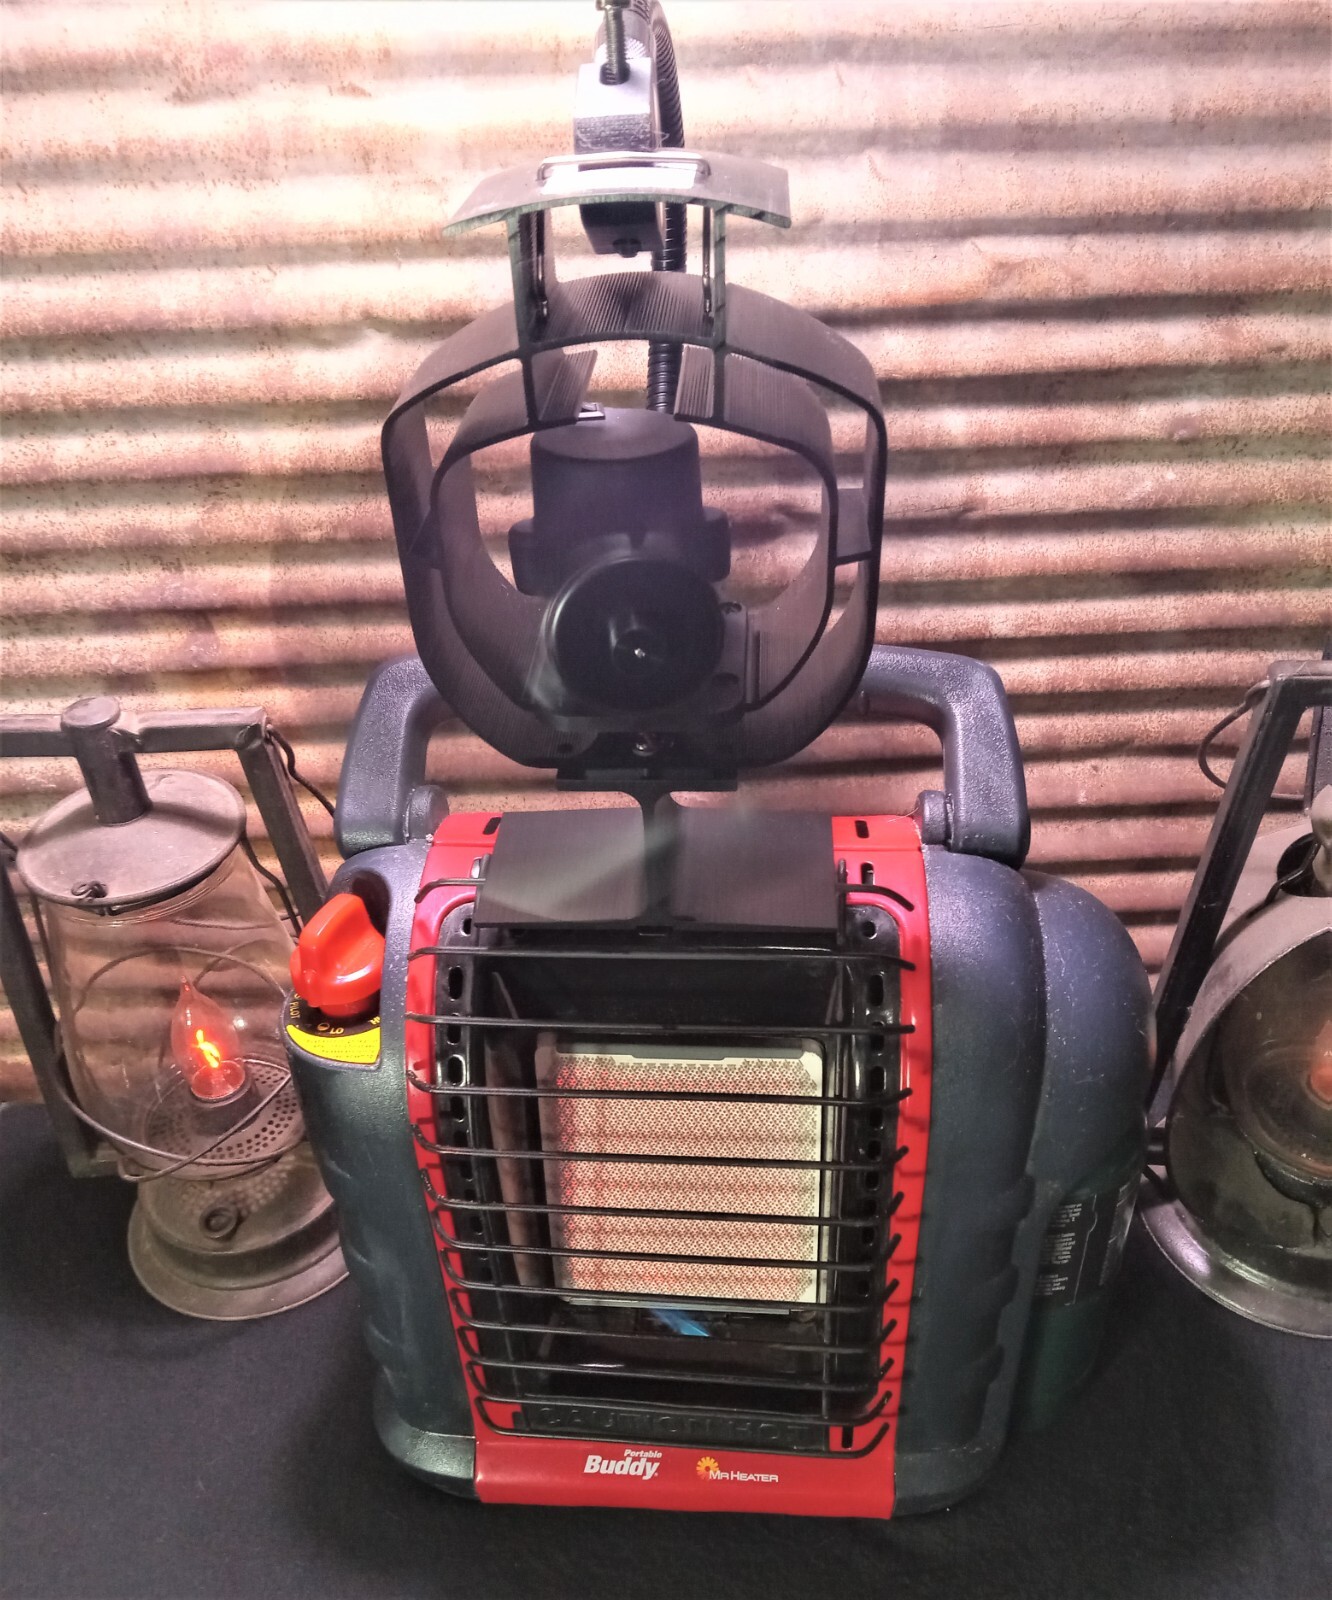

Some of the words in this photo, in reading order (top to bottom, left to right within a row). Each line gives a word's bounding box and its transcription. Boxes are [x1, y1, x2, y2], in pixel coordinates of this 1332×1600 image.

[289, 1001, 300, 1018] PILOT
[330, 1027, 344, 1035] LO
[623, 1448, 663, 1459] Portable
[583, 1454, 661, 1481] Buddy
[730, 1470, 779, 1483] HEATER
